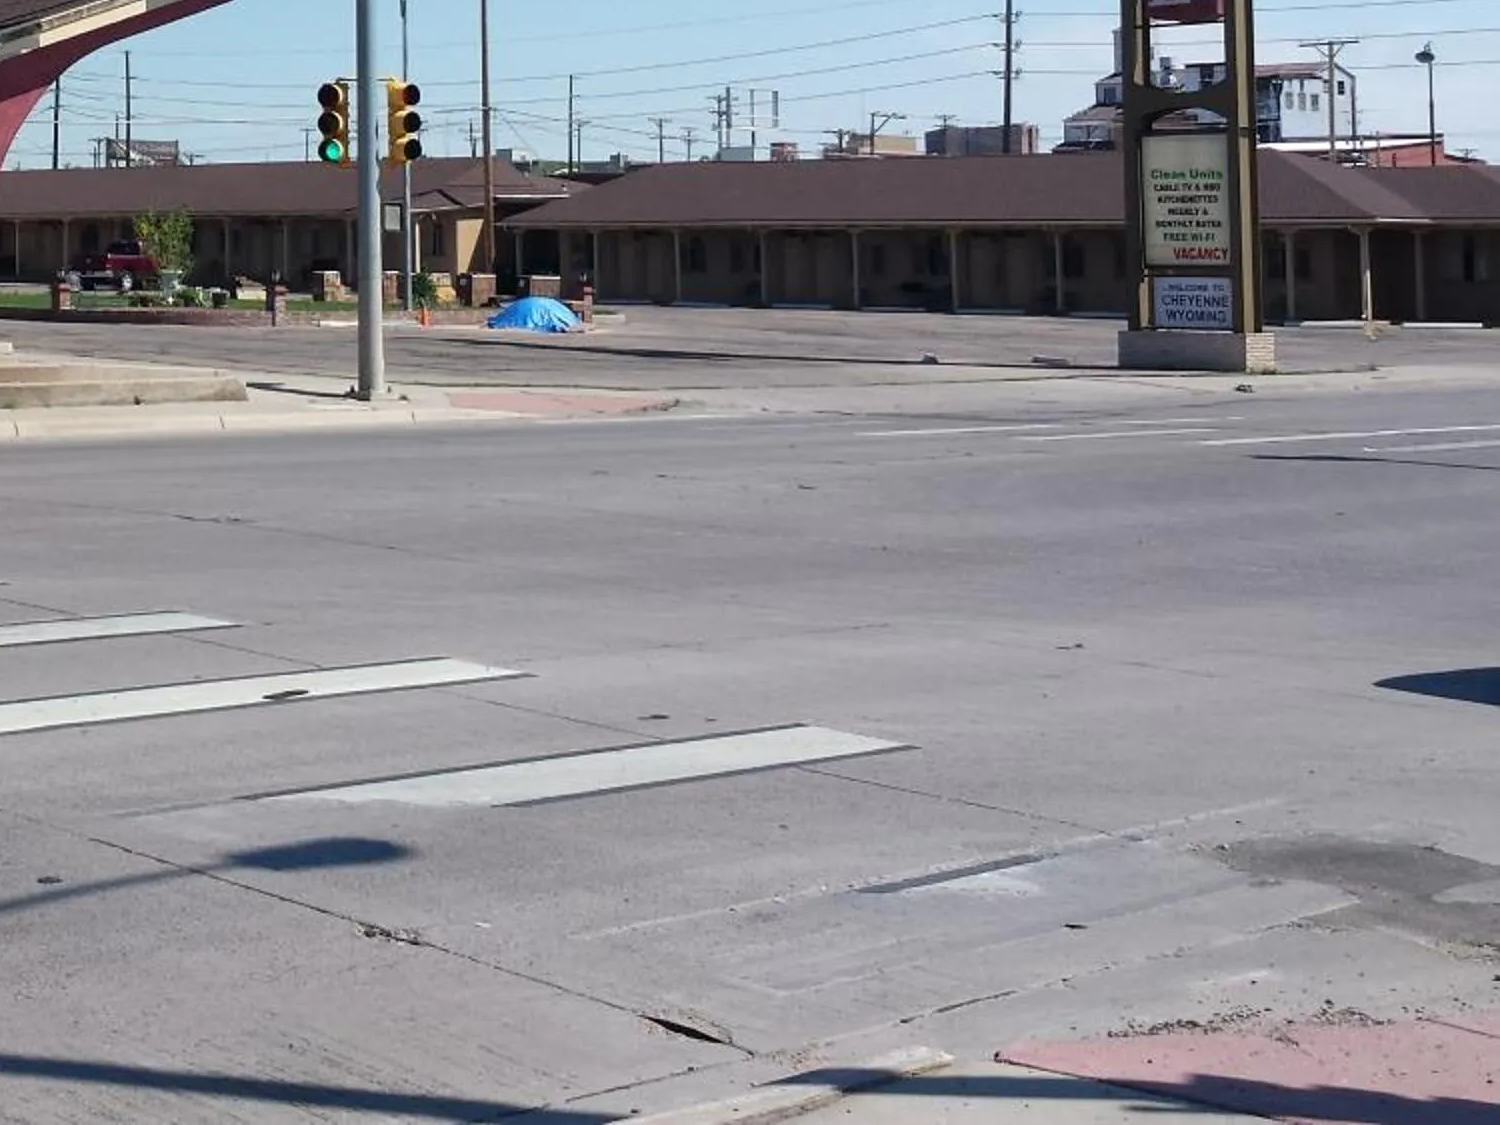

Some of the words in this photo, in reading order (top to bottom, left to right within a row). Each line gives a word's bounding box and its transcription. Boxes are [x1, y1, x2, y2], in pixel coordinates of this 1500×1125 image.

[1151, 169, 1186, 180] Clean
[1189, 168, 1223, 180] Units
[1154, 183, 1179, 192] CABLE
[1182, 183, 1193, 192] TV
[1157, 195, 1219, 204] KITCHENETTES
[1167, 207, 1199, 216] WEEKLY
[1155, 220, 1193, 228] MONTHLY
[1163, 232, 1188, 242] FREE
[1191, 232, 1215, 242] WI-FI
[1173, 246, 1229, 260] VACANCY
[1161, 294, 1229, 308] CHEYENNE
[1166, 309, 1227, 323] WYOMING
